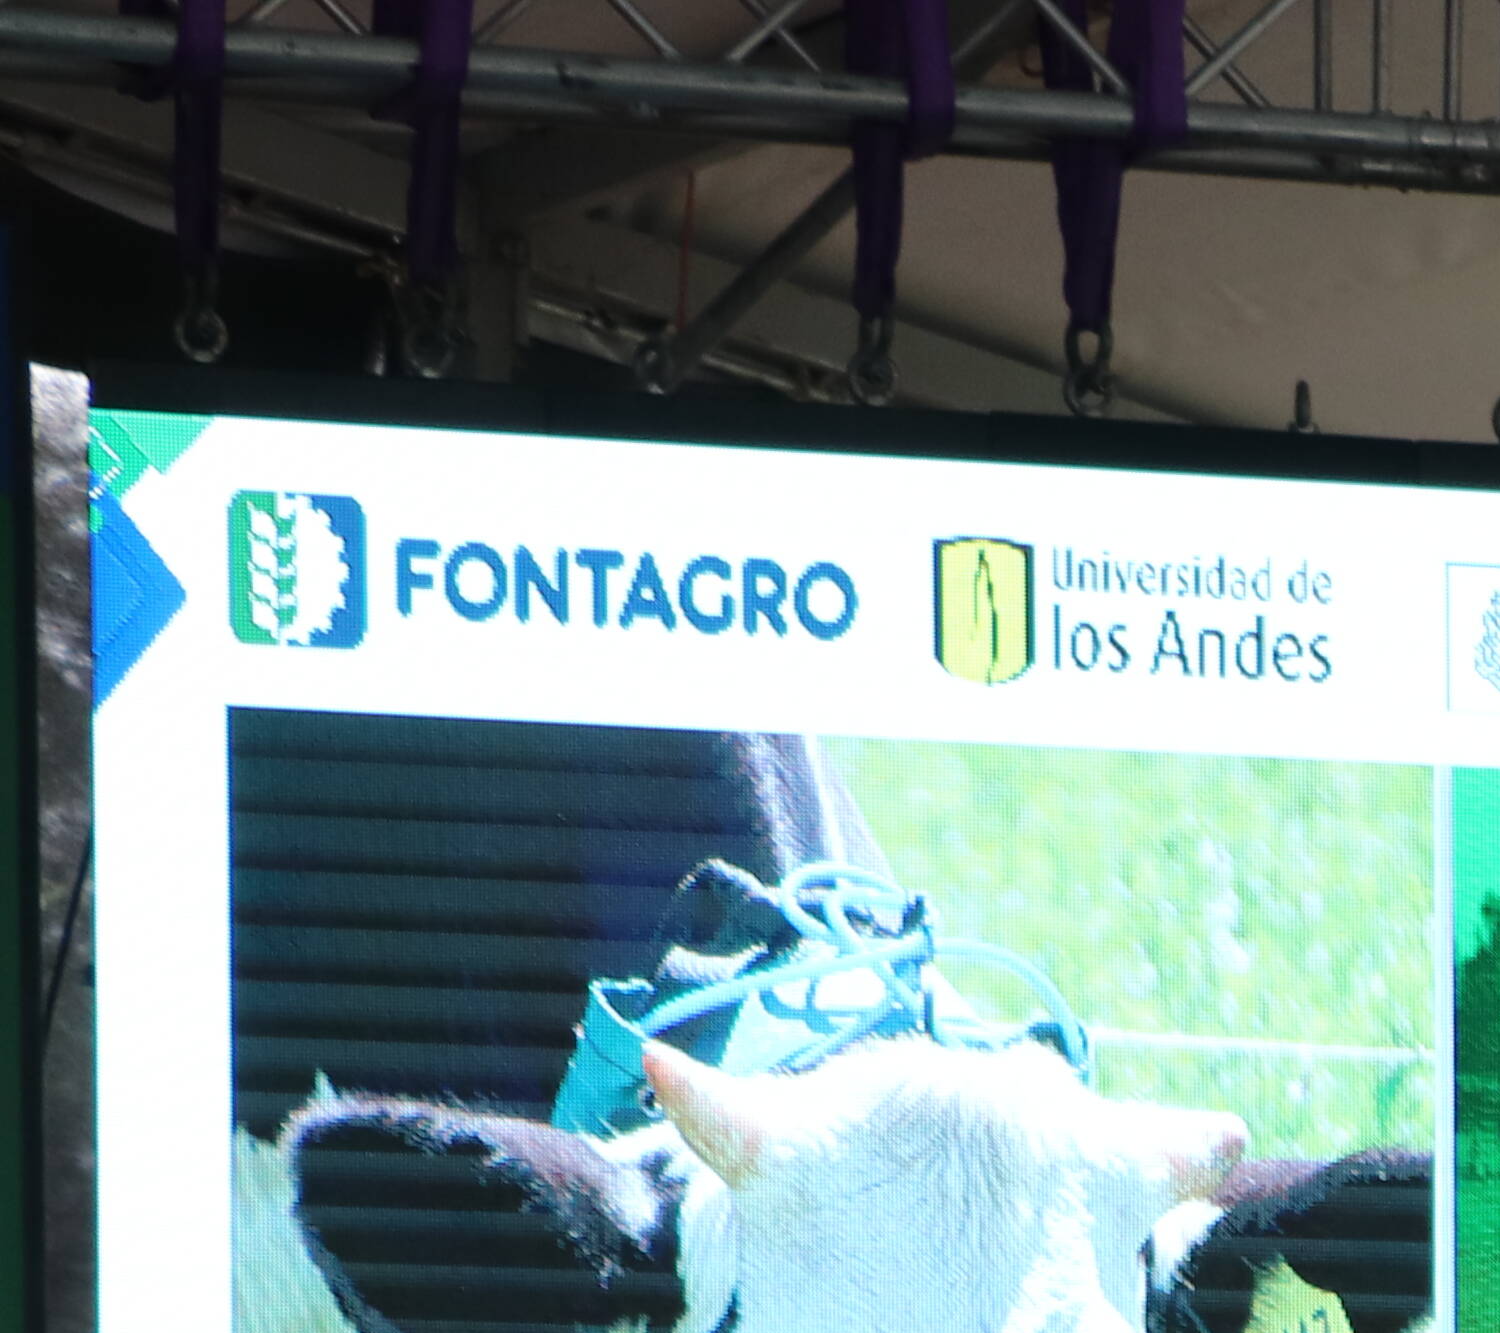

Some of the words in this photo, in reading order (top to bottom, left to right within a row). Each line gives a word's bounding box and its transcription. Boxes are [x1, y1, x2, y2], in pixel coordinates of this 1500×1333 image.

[396, 539, 858, 641] FONTAGRO
[1052, 546, 1273, 603] Universidad
[1286, 559, 1333, 606] de
[1052, 602, 1132, 673] los
[1150, 612, 1333, 684] Andes
